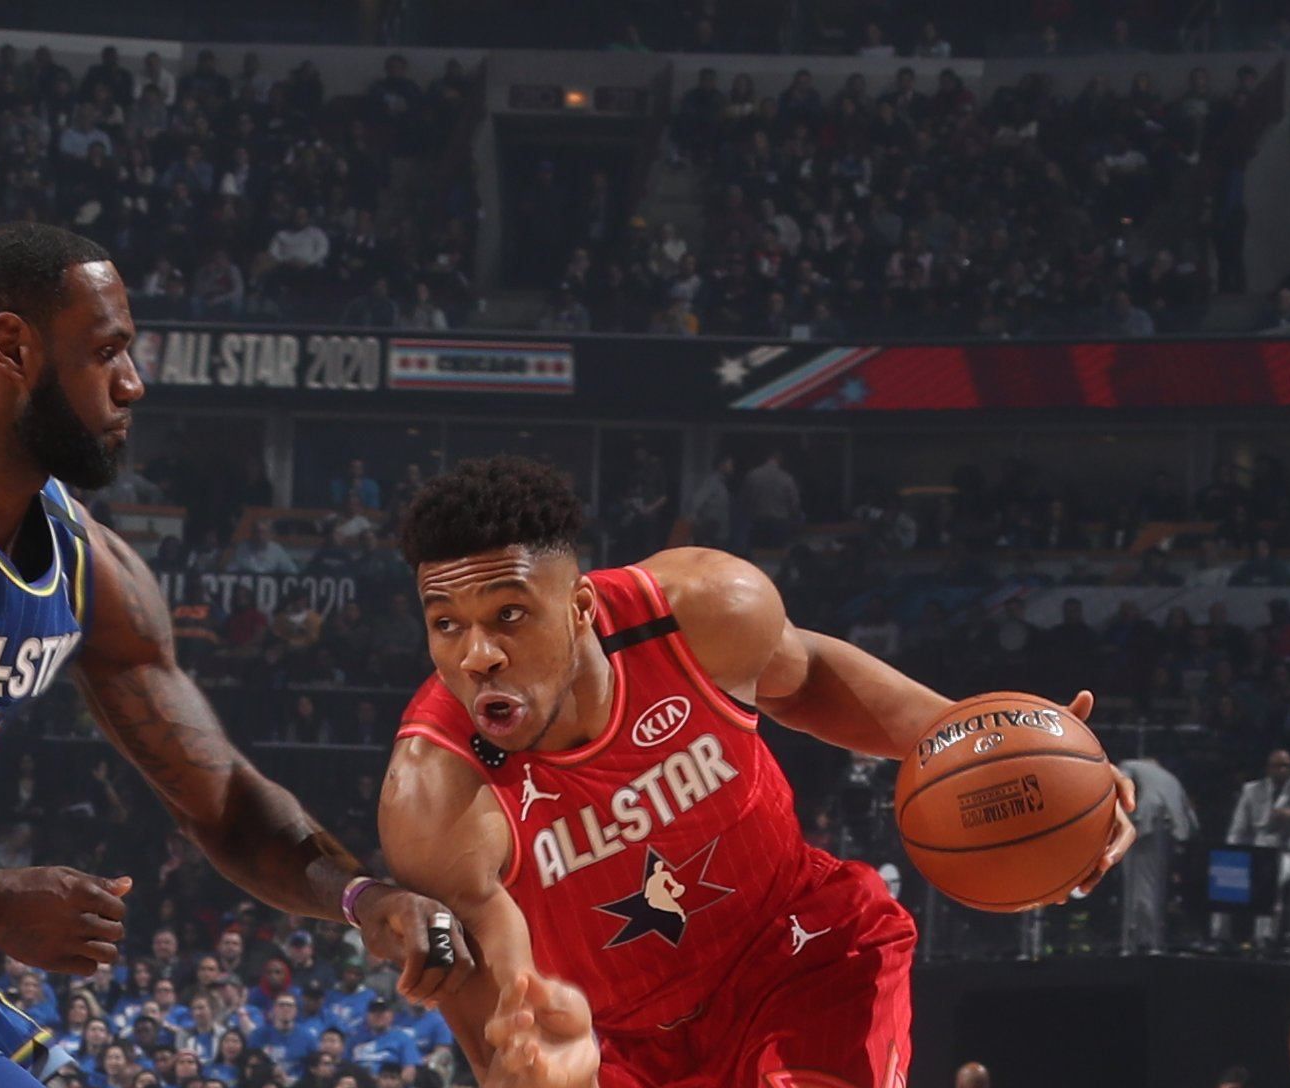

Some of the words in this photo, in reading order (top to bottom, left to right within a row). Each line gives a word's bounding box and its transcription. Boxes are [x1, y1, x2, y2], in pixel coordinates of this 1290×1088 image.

[308, 336, 381, 391] 2020
[639, 703, 684, 741] KIA
[918, 708, 1064, 769] SPALDING
[533, 733, 740, 889] ALL-STAR
